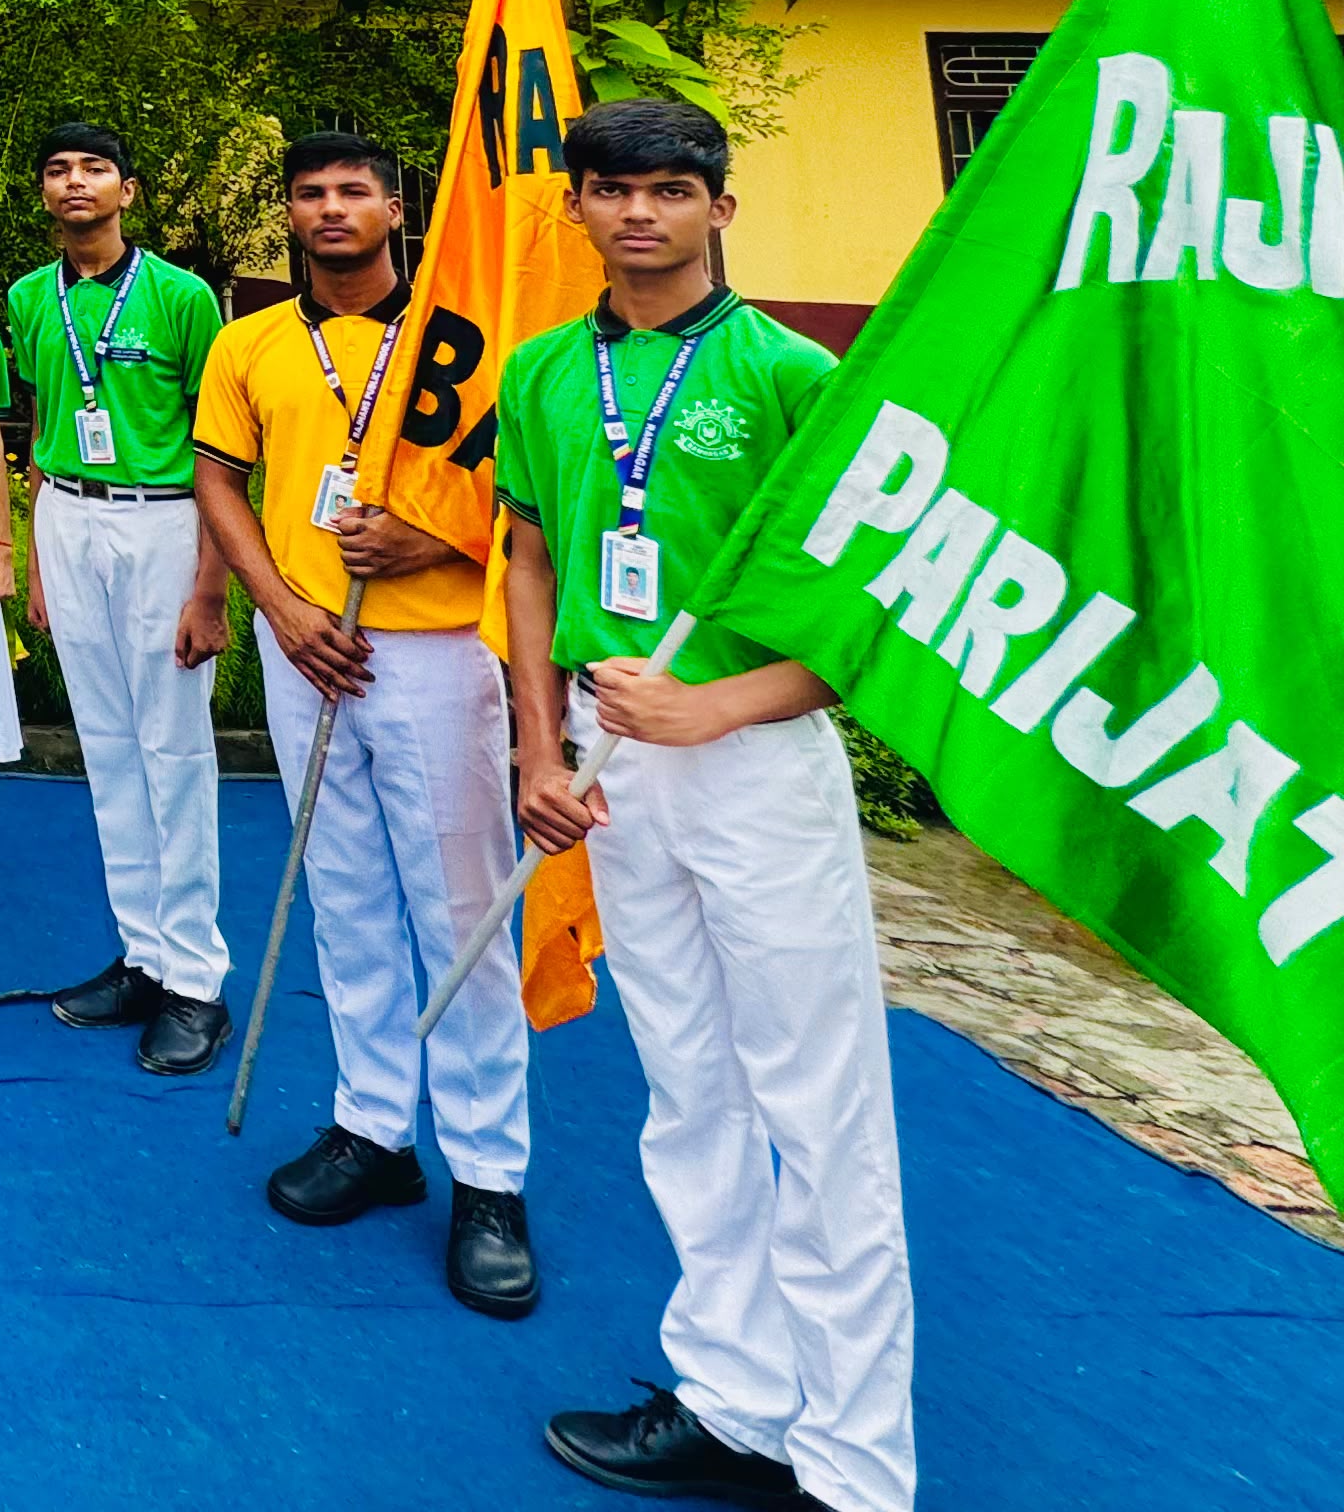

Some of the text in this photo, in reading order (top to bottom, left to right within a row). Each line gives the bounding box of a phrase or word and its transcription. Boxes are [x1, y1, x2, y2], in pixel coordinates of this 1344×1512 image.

[667, 342, 694, 389] PUBLIC
[649, 383, 677, 425] SCHOOL,
[630, 423, 657, 480] RAMNAGAR
[801, 399, 1344, 968] PARIJAT
